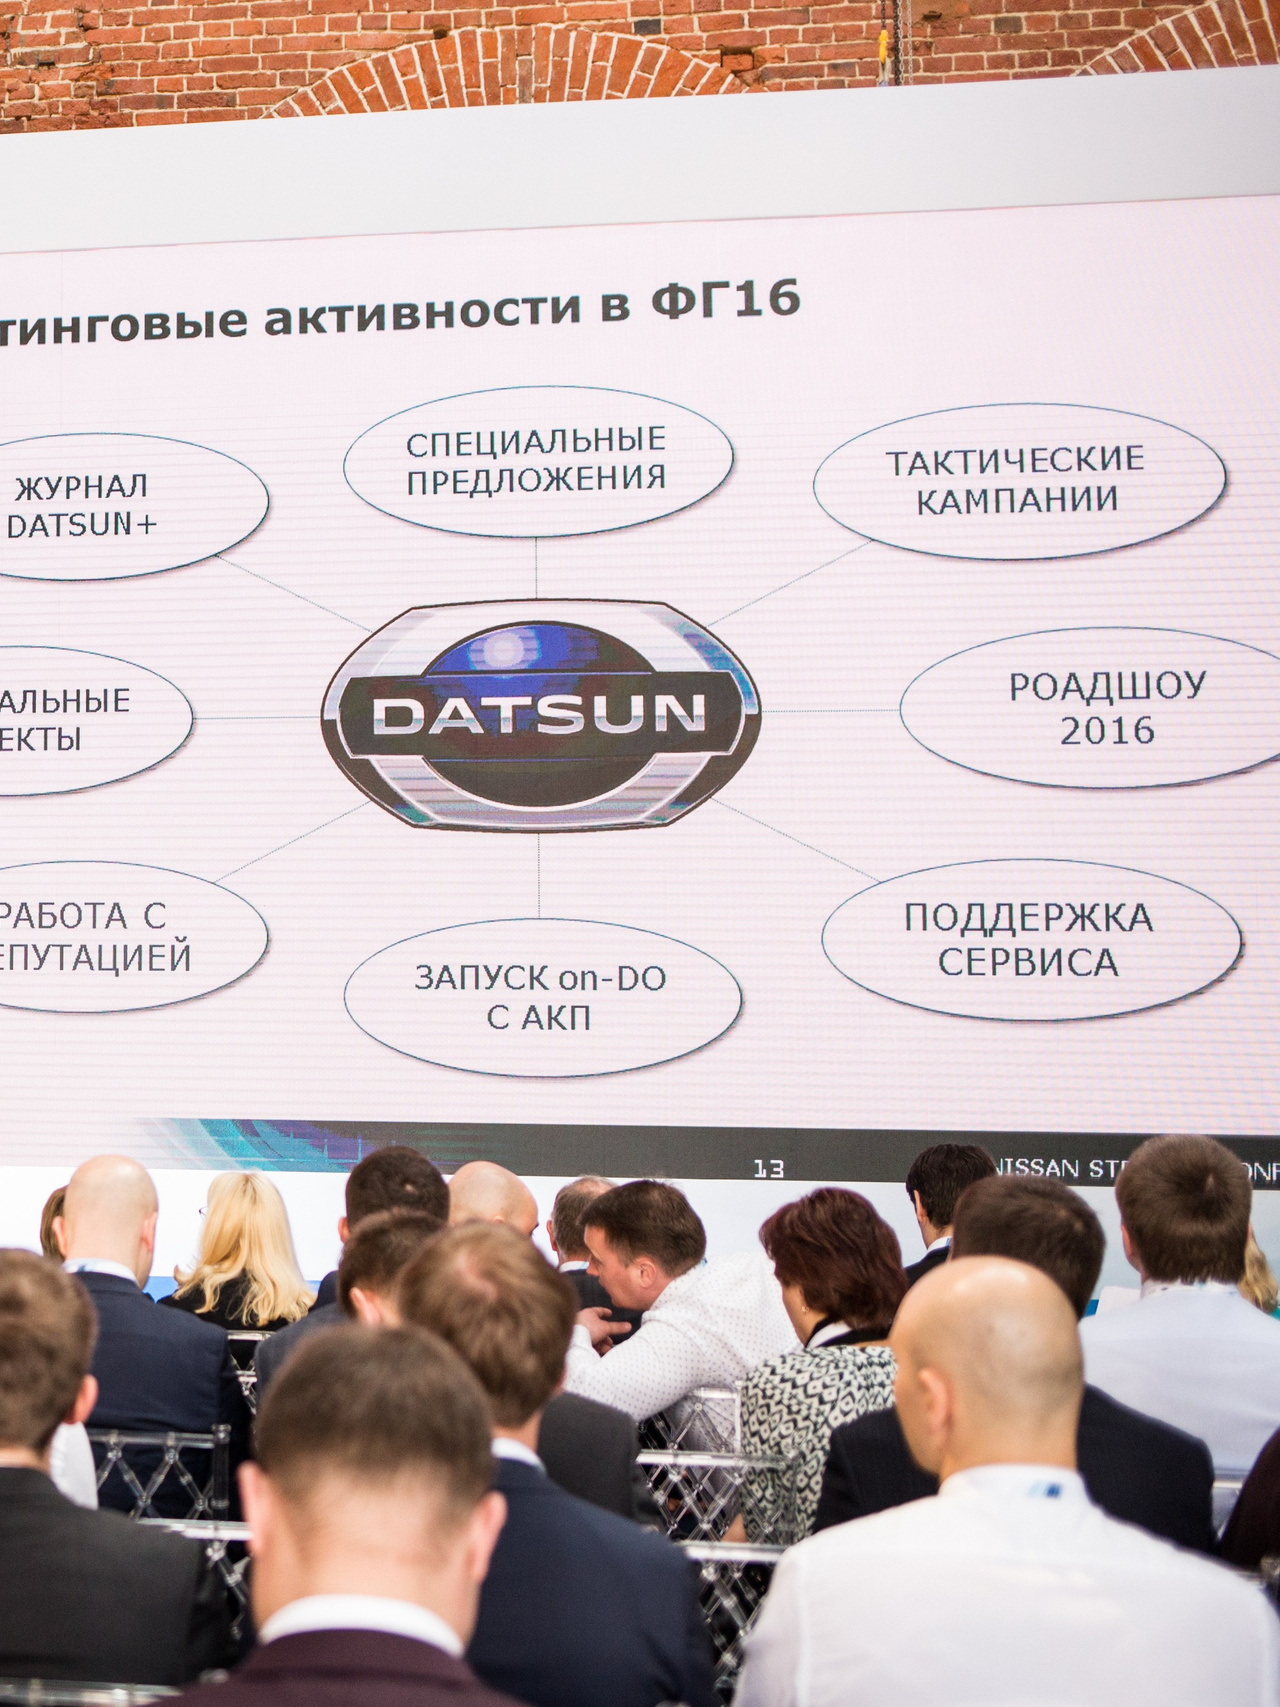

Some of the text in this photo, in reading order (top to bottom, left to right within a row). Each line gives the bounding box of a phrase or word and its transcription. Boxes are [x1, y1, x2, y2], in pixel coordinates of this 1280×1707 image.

[263, 295, 580, 336] активности
[601, 293, 631, 322] в
[650, 278, 801, 320] ФГ16
[406, 425, 666, 460] СПЕЦИАЛЬНЫЕ
[885, 444, 1144, 477] ТАКТИЧЕСКИЕ
[14, 473, 147, 502] ЖУРНАЛ
[407, 463, 665, 499] ПРЕДЛОЖЕНИЯ
[917, 485, 1118, 516] КАМПАНИИ
[7, 511, 158, 539] DATSUN+
[1010, 670, 1207, 707] РОАДШОУ
[373, 694, 706, 735] DATSUN
[1060, 715, 1155, 745] 2016
[144, 902, 166, 930] С
[905, 902, 1154, 938] ПОДДЕРЖКА
[938, 947, 1119, 977] СЕРВИСА
[414, 964, 666, 992] ЗАПУСК on-DO
[487, 1004, 590, 1031] С АКП
[753, 1159, 785, 1180] 13
